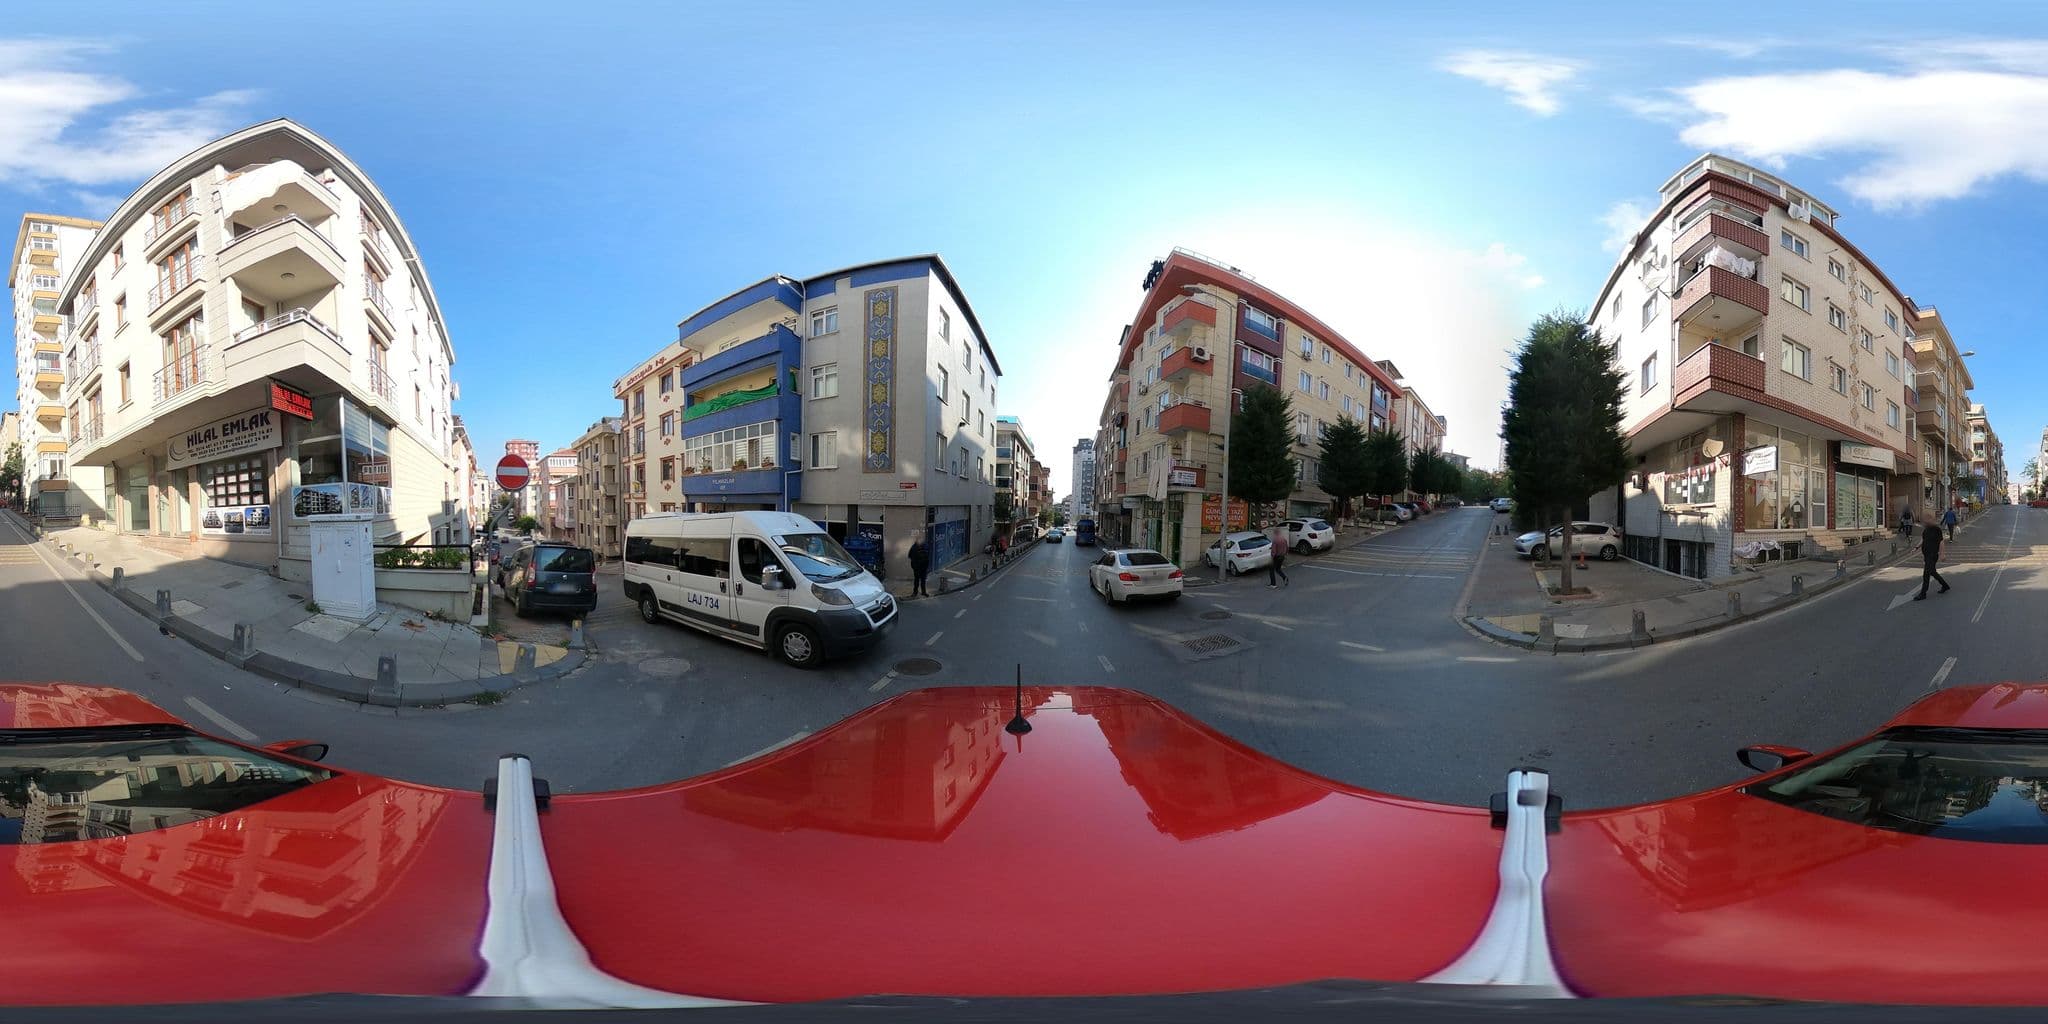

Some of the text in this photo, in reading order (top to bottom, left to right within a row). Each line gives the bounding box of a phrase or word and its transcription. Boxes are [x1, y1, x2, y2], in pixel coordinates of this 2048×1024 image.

[187, 411, 271, 449] HİLAL EMLAK
[687, 592, 720, 610] LAJ 734
